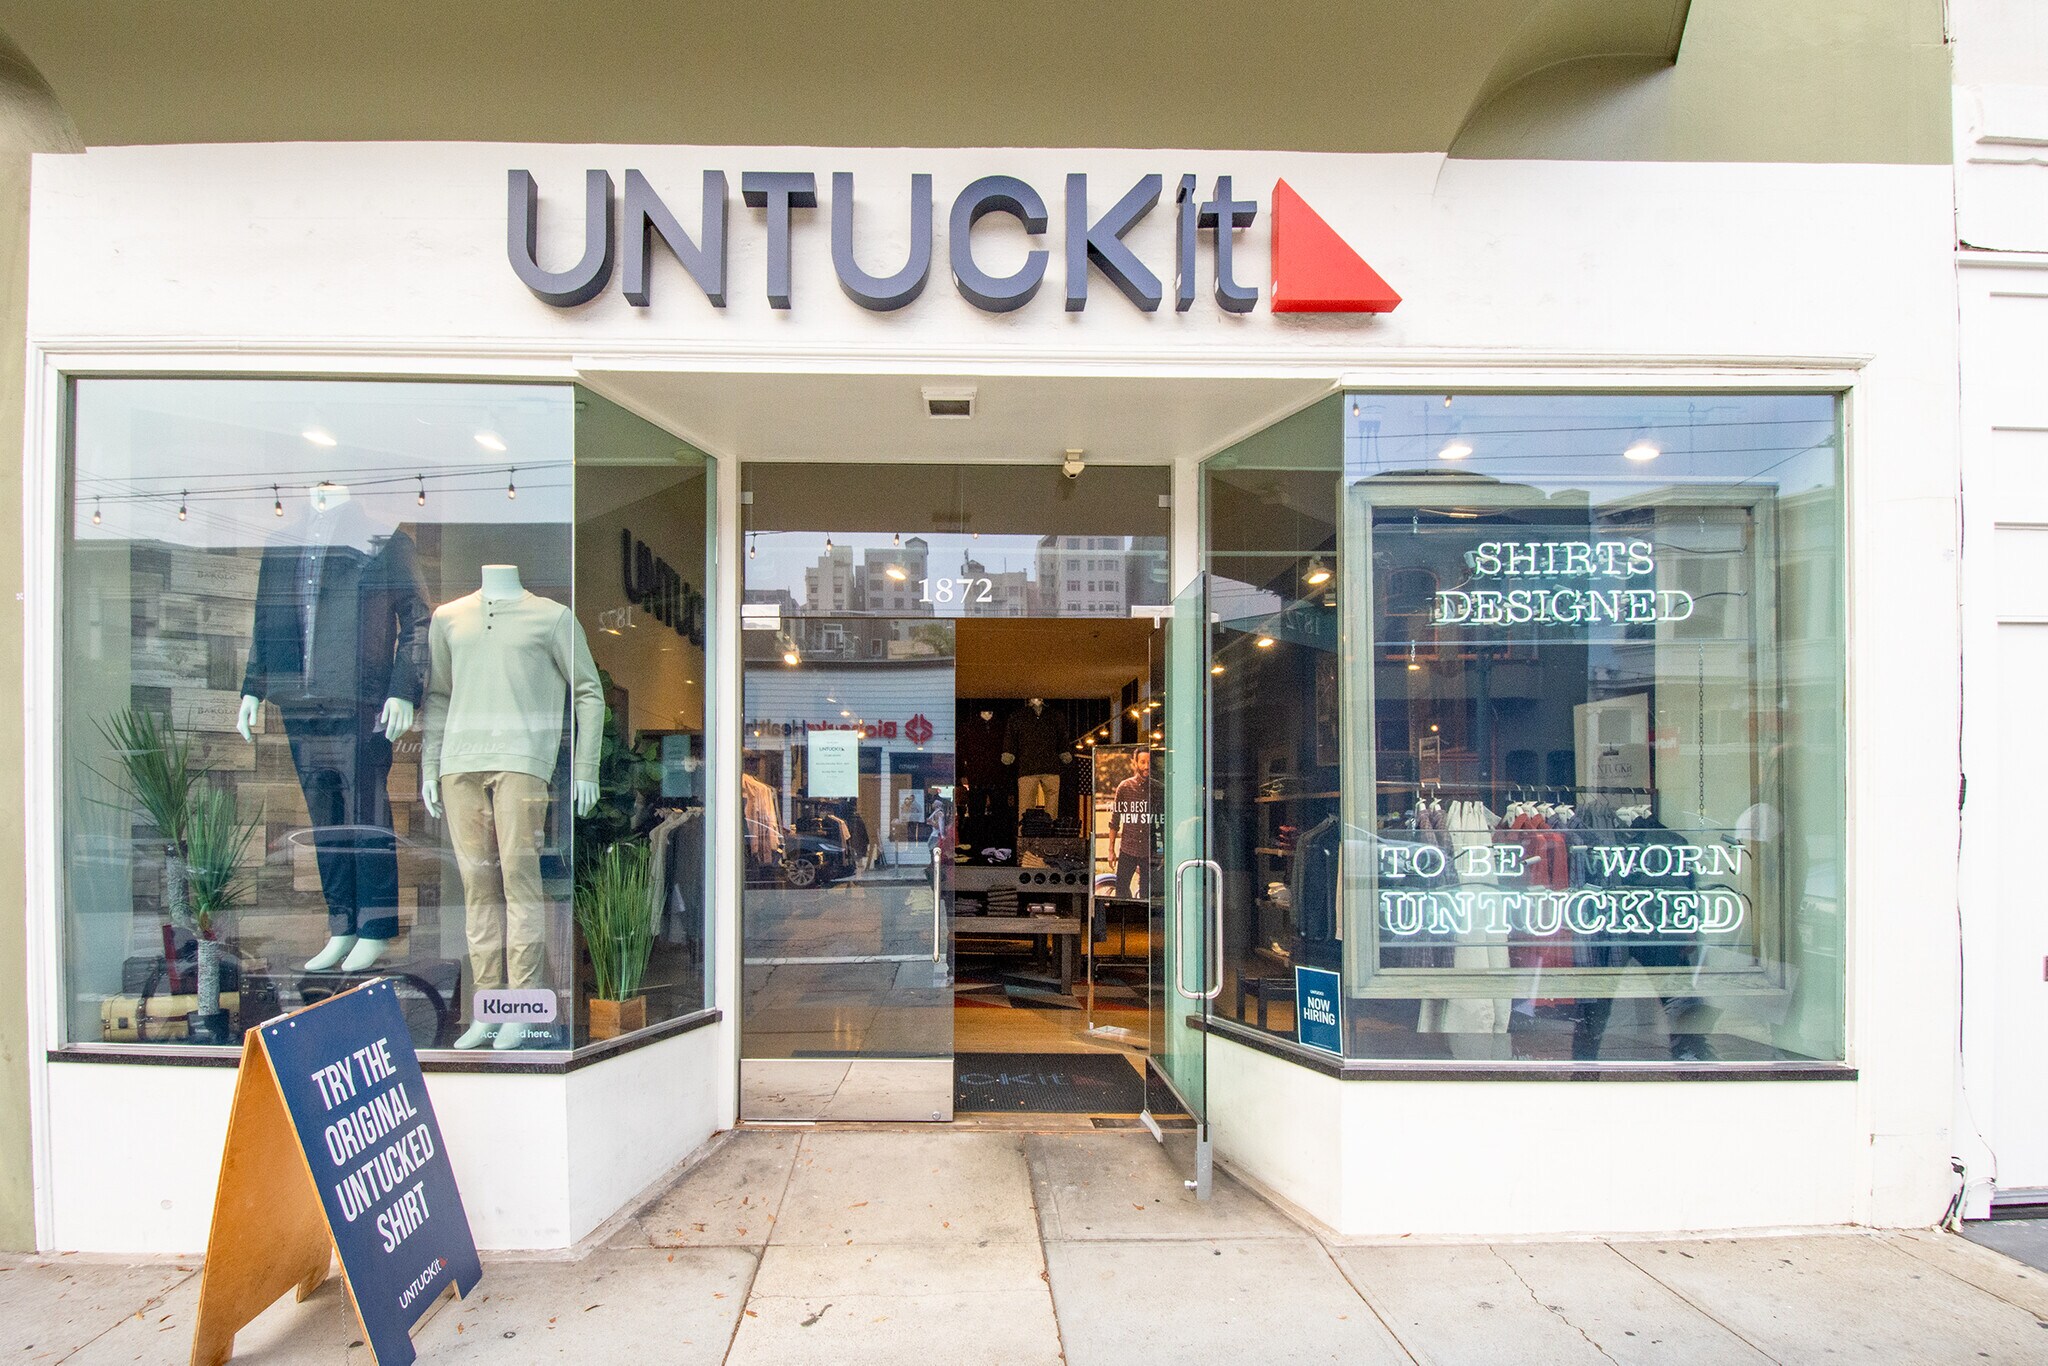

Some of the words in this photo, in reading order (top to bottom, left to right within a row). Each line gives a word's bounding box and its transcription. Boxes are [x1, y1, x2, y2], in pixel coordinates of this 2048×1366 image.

[507, 168, 1259, 314] UNTUCKit
[1475, 540, 1655, 576] SHIRTS
[918, 577, 993, 604] 1872
[1435, 589, 1695, 624] DESIGNED
[1120, 813, 1139, 824] NEW
[1130, 801, 1148, 813] BEST
[1381, 845, 1446, 878] TO
[1459, 845, 1525, 878] BE
[1593, 845, 1746, 878] WORN
[1380, 891, 1745, 936] UNTUCKED
[483, 999, 549, 1014] Klarna.
[1303, 1007, 1336, 1026] HIRING
[1307, 996, 1331, 1012] NOW
[479, 1030, 526, 1039] Acced
[527, 1029, 552, 1038] here.
[311, 1056, 357, 1111] TRY
[352, 1037, 397, 1088] THE
[324, 1082, 418, 1167] ORIGINAL
[334, 1123, 435, 1223] UNTUCKED
[376, 1180, 431, 1254] SHIRT
[398, 1258, 442, 1309] UNTUCKit
